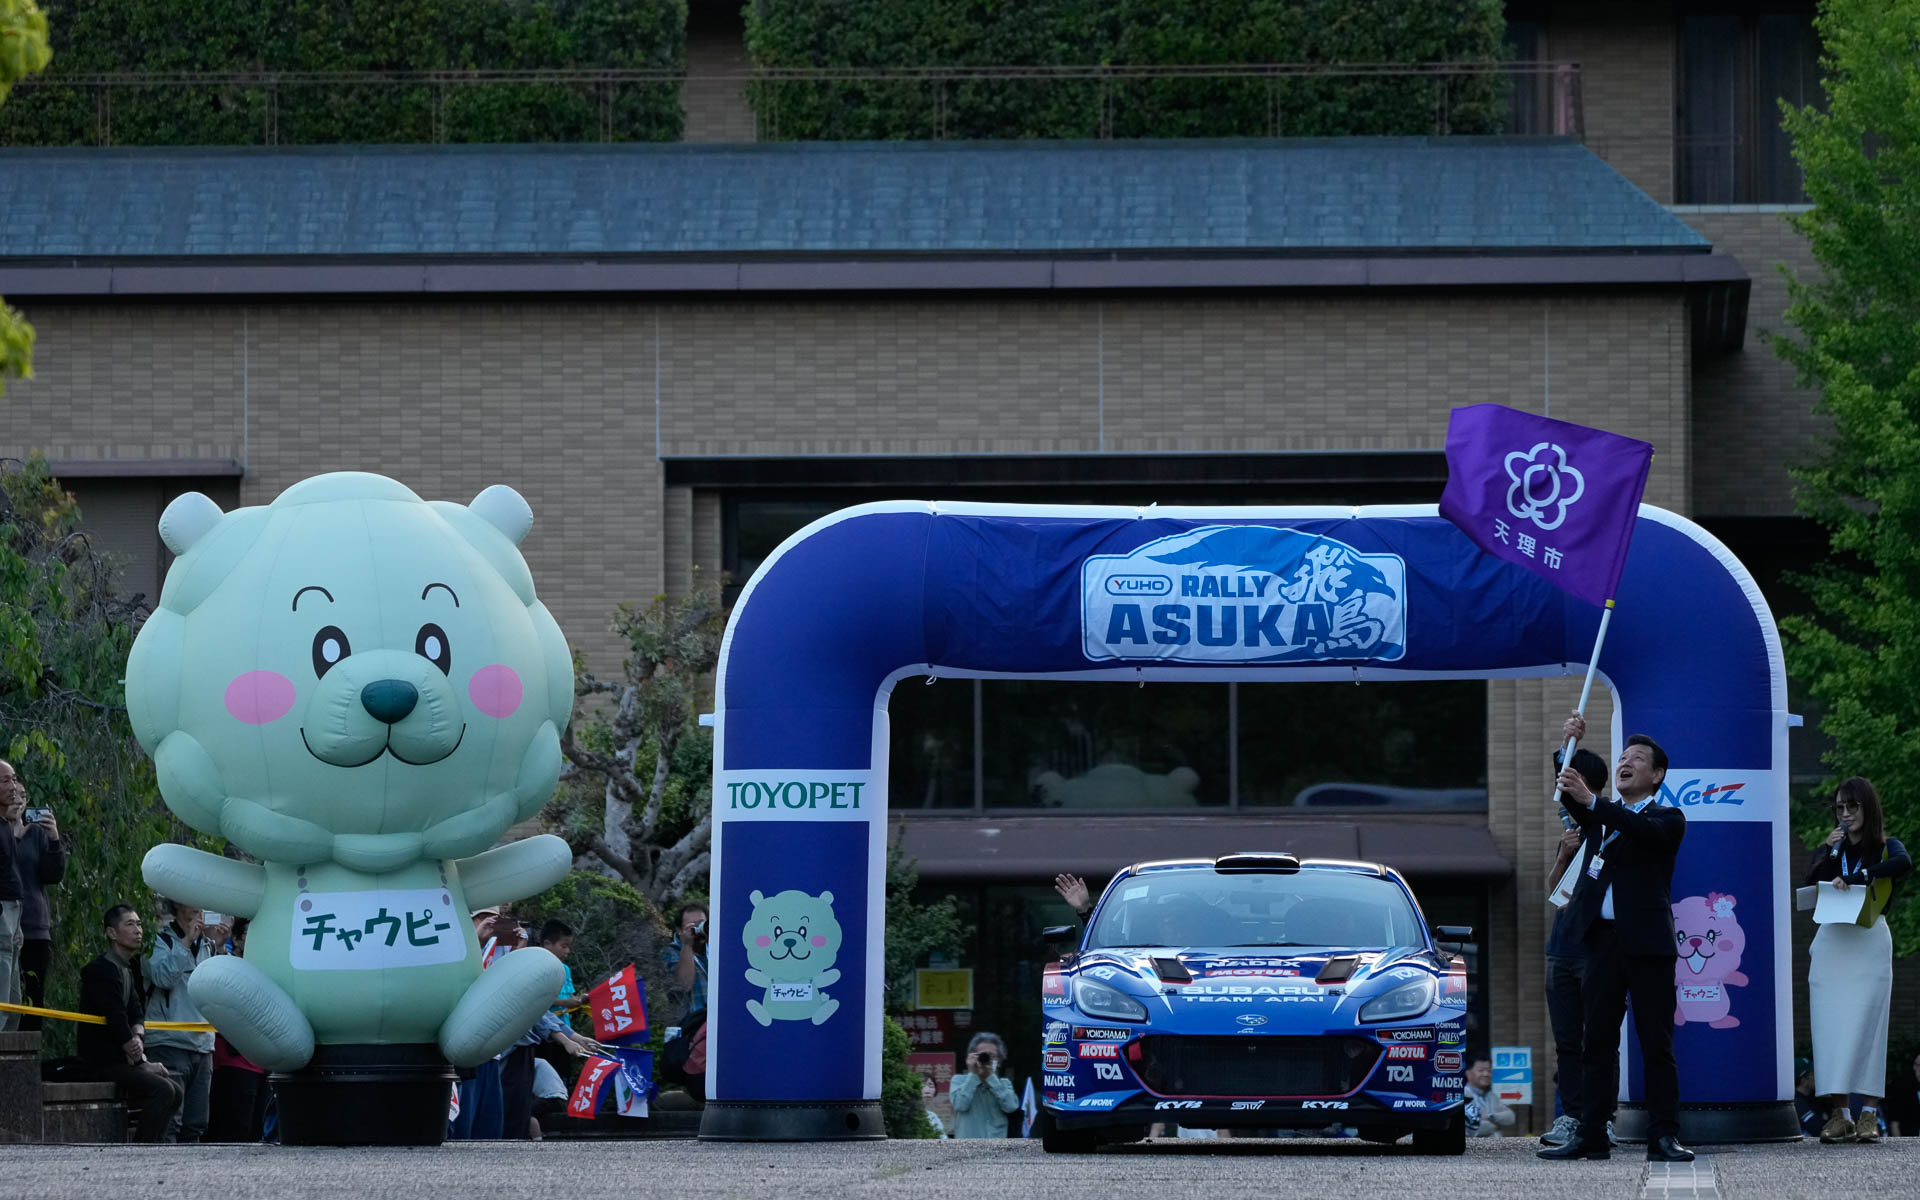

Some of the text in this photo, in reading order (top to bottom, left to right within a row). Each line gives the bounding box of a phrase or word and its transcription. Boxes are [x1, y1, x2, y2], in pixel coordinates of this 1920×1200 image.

[1494, 518, 1564, 570] 天理市
[1114, 574, 1272, 598] YUHO RALLY
[1105, 602, 1336, 647] ASUKA
[727, 781, 866, 809] TOYOPET
[1656, 778, 1746, 807] Netz
[302, 908, 450, 951] チャウピー
[1205, 960, 1300, 968] NADEX
[773, 987, 808, 998] チャウピー
[1181, 986, 1325, 995] SUBARU
[1683, 988, 1719, 1000] チャウニー
[1085, 1029, 1128, 1039] YOKOHAMA
[1391, 1030, 1433, 1040] YOKOHAMA
[1080, 1045, 1117, 1057] MOTUL
[1388, 1046, 1425, 1058] MOTUL
[1093, 1063, 1124, 1080] TOA
[1386, 1065, 1415, 1082] TOA
[1044, 1075, 1076, 1087] NADEX
[1432, 1077, 1463, 1088] NADEX
[1154, 1101, 1203, 1110] KYB
[1302, 1101, 1349, 1110] KYB
[1404, 1100, 1427, 1108] WORK
